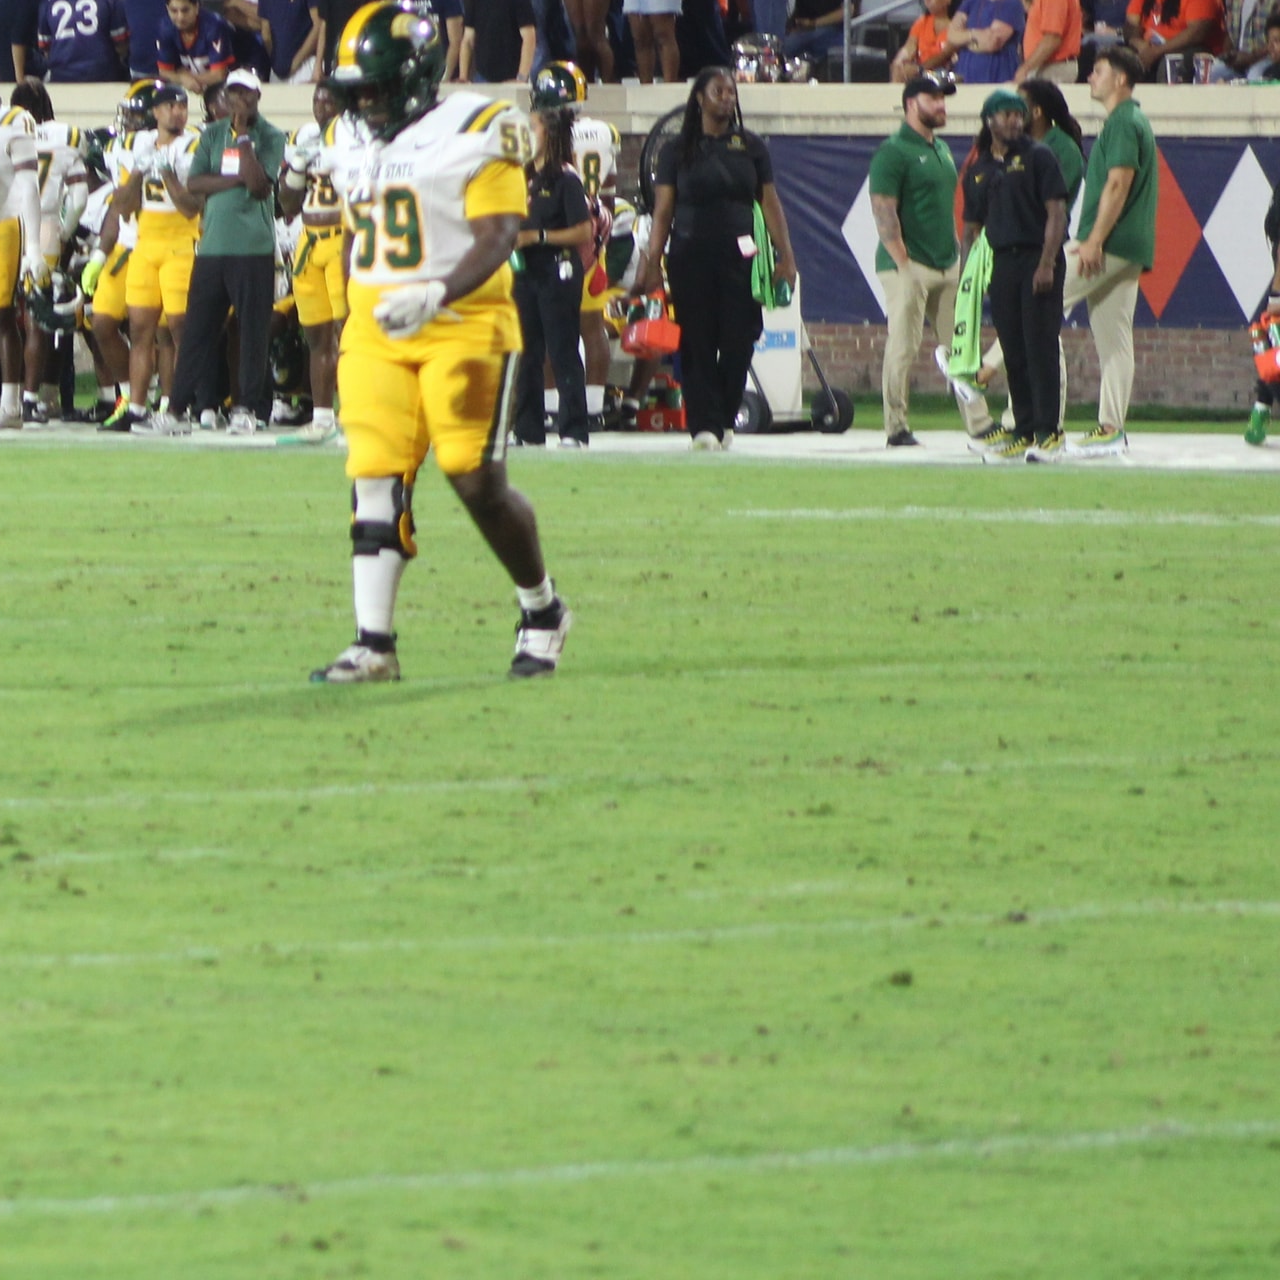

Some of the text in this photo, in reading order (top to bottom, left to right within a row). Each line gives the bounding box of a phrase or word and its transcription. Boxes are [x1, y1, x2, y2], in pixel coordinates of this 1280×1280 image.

[500, 122, 532, 157] 59
[385, 162, 415, 179] STATE
[349, 181, 426, 273] 59
